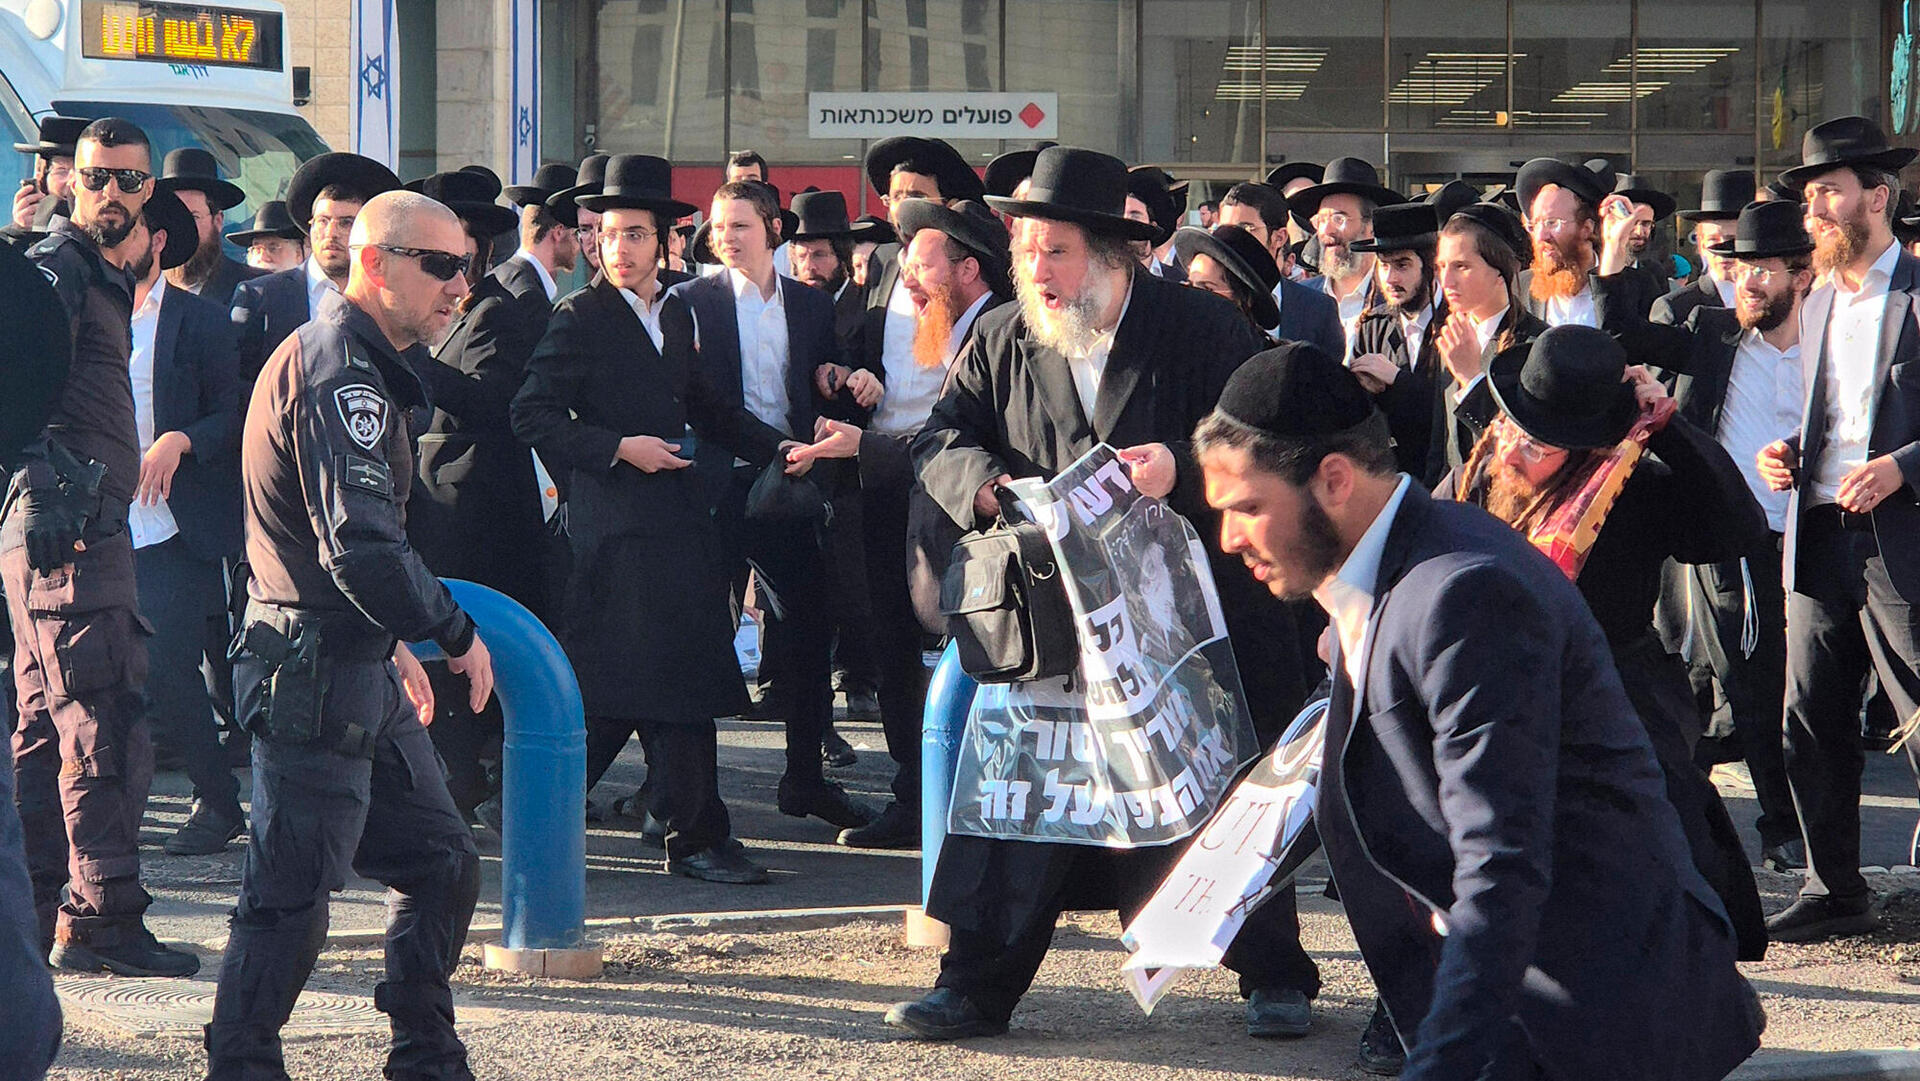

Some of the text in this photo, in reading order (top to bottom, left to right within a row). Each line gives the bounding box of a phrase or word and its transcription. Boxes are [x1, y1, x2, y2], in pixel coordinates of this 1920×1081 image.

[820, 105, 1012, 125] פועלים משכנתאות
[980, 779, 1032, 820] זה
